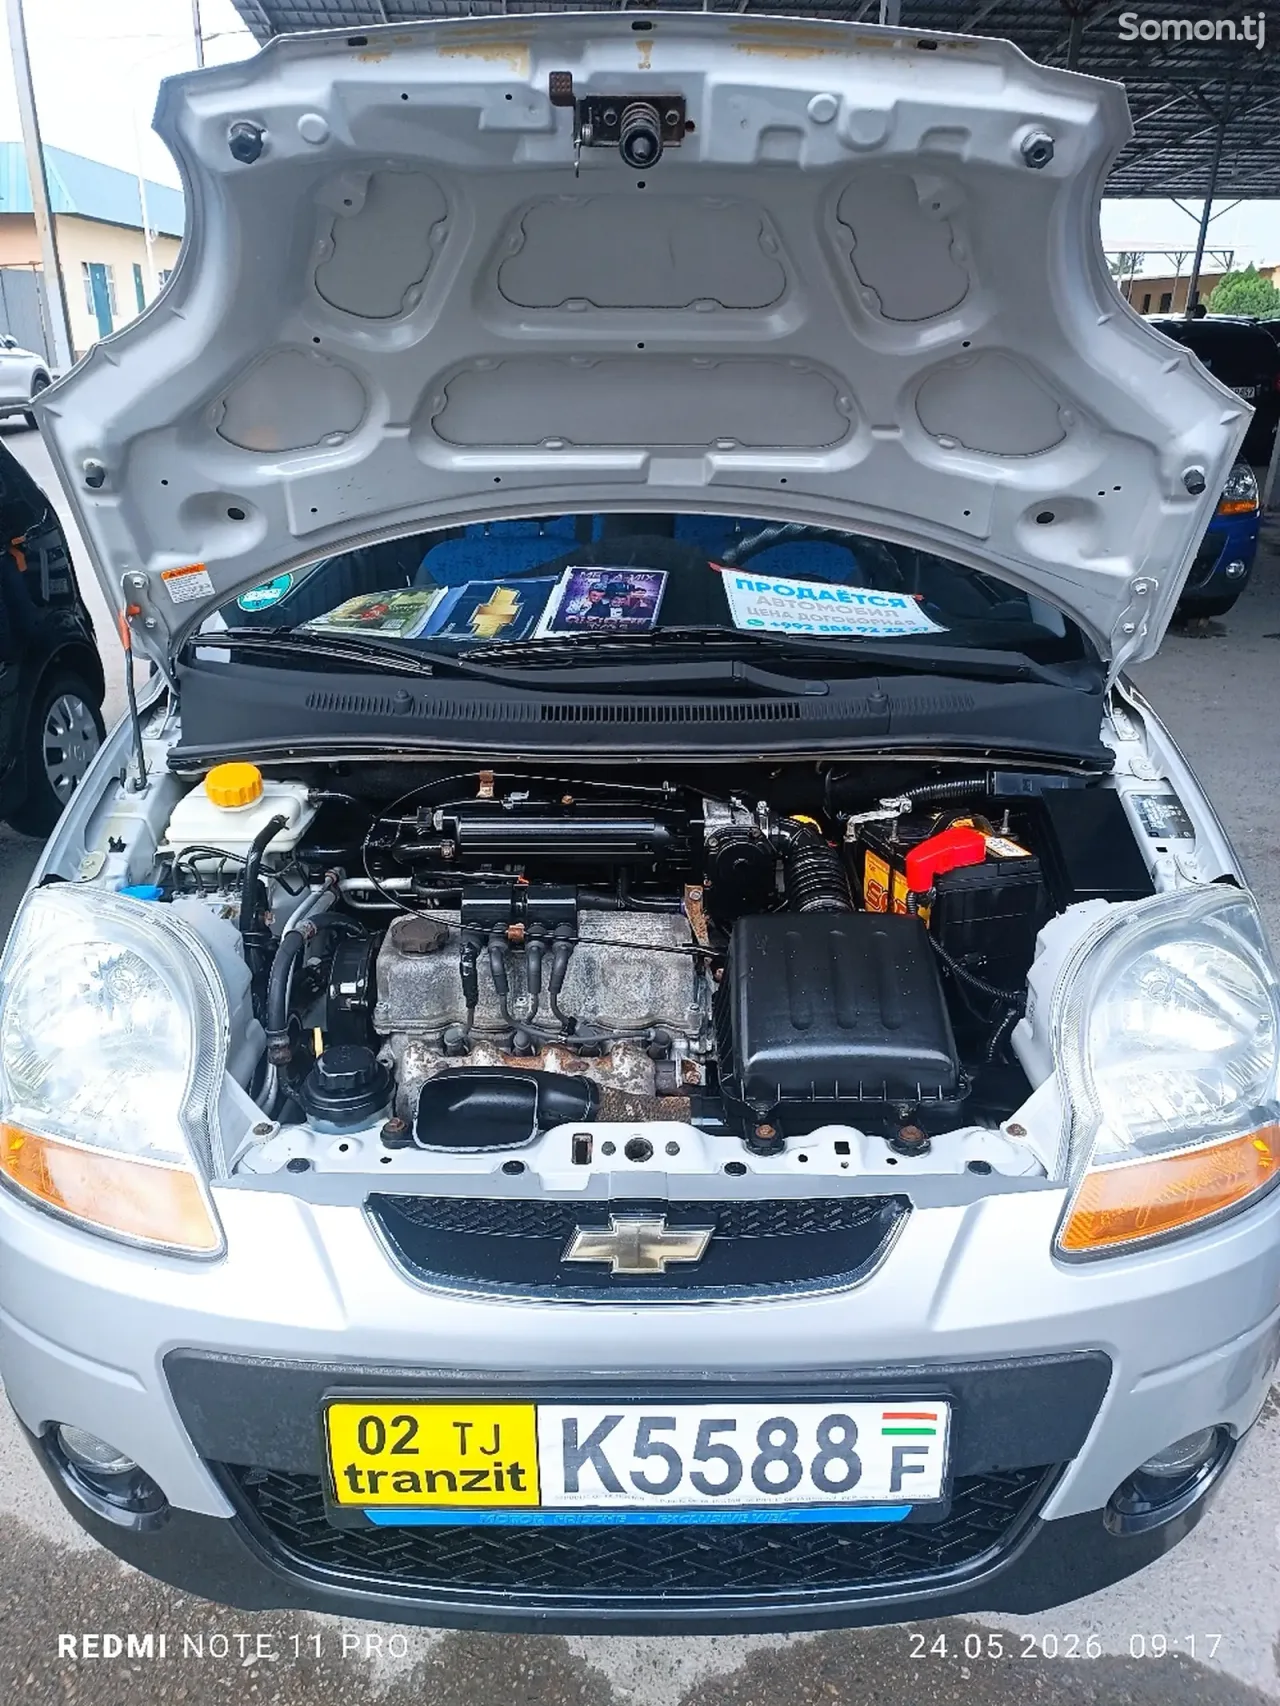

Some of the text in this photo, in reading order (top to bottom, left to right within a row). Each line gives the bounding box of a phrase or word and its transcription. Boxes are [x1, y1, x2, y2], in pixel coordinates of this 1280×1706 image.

[736, 578, 907, 608] ПРОДАЁТСЯ
[746, 606, 793, 618] ЦЕНА
[358, 1415, 500, 1456] 02 TJ
[562, 1413, 862, 1496] K5588
[889, 1446, 929, 1492] F
[343, 1461, 526, 1494] tranzit
